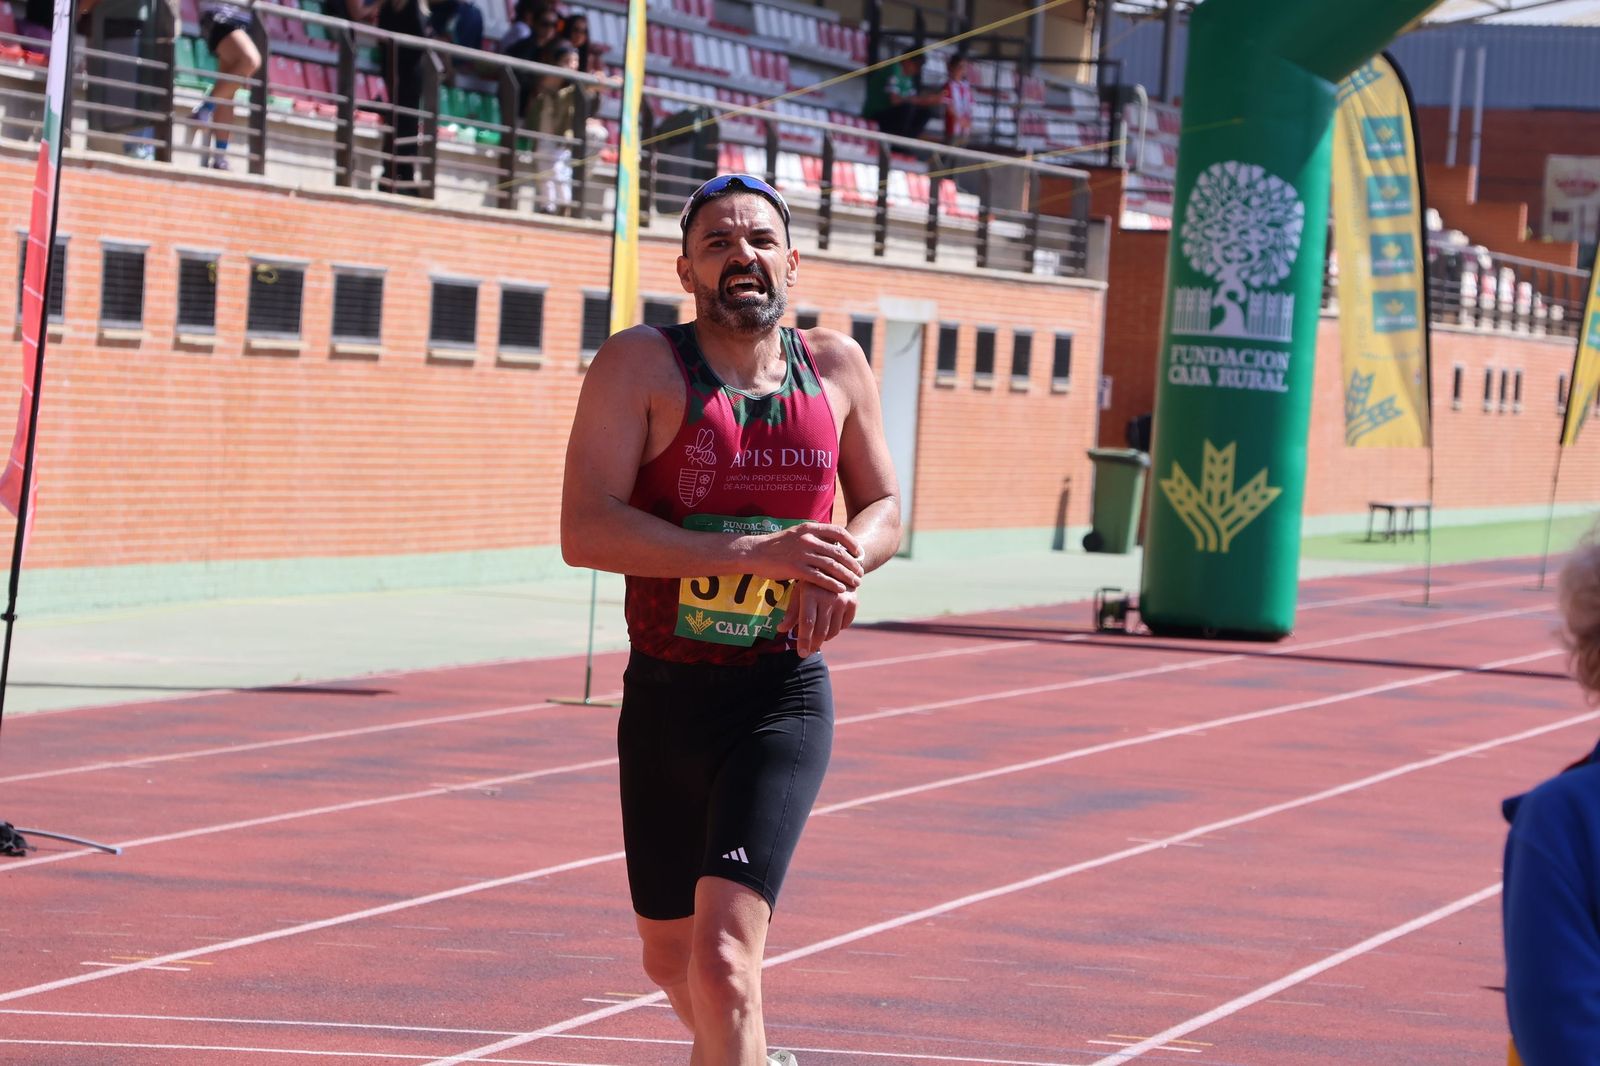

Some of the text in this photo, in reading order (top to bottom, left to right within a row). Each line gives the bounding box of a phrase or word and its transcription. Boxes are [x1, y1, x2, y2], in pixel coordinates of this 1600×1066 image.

[1170, 344, 1291, 370] FUNDACION
[1168, 364, 1289, 393] CAJA RURAL
[729, 448, 832, 469] APIS DURI
[752, 474, 812, 482] PROFESIONAL
[715, 620, 750, 637] CAJA
